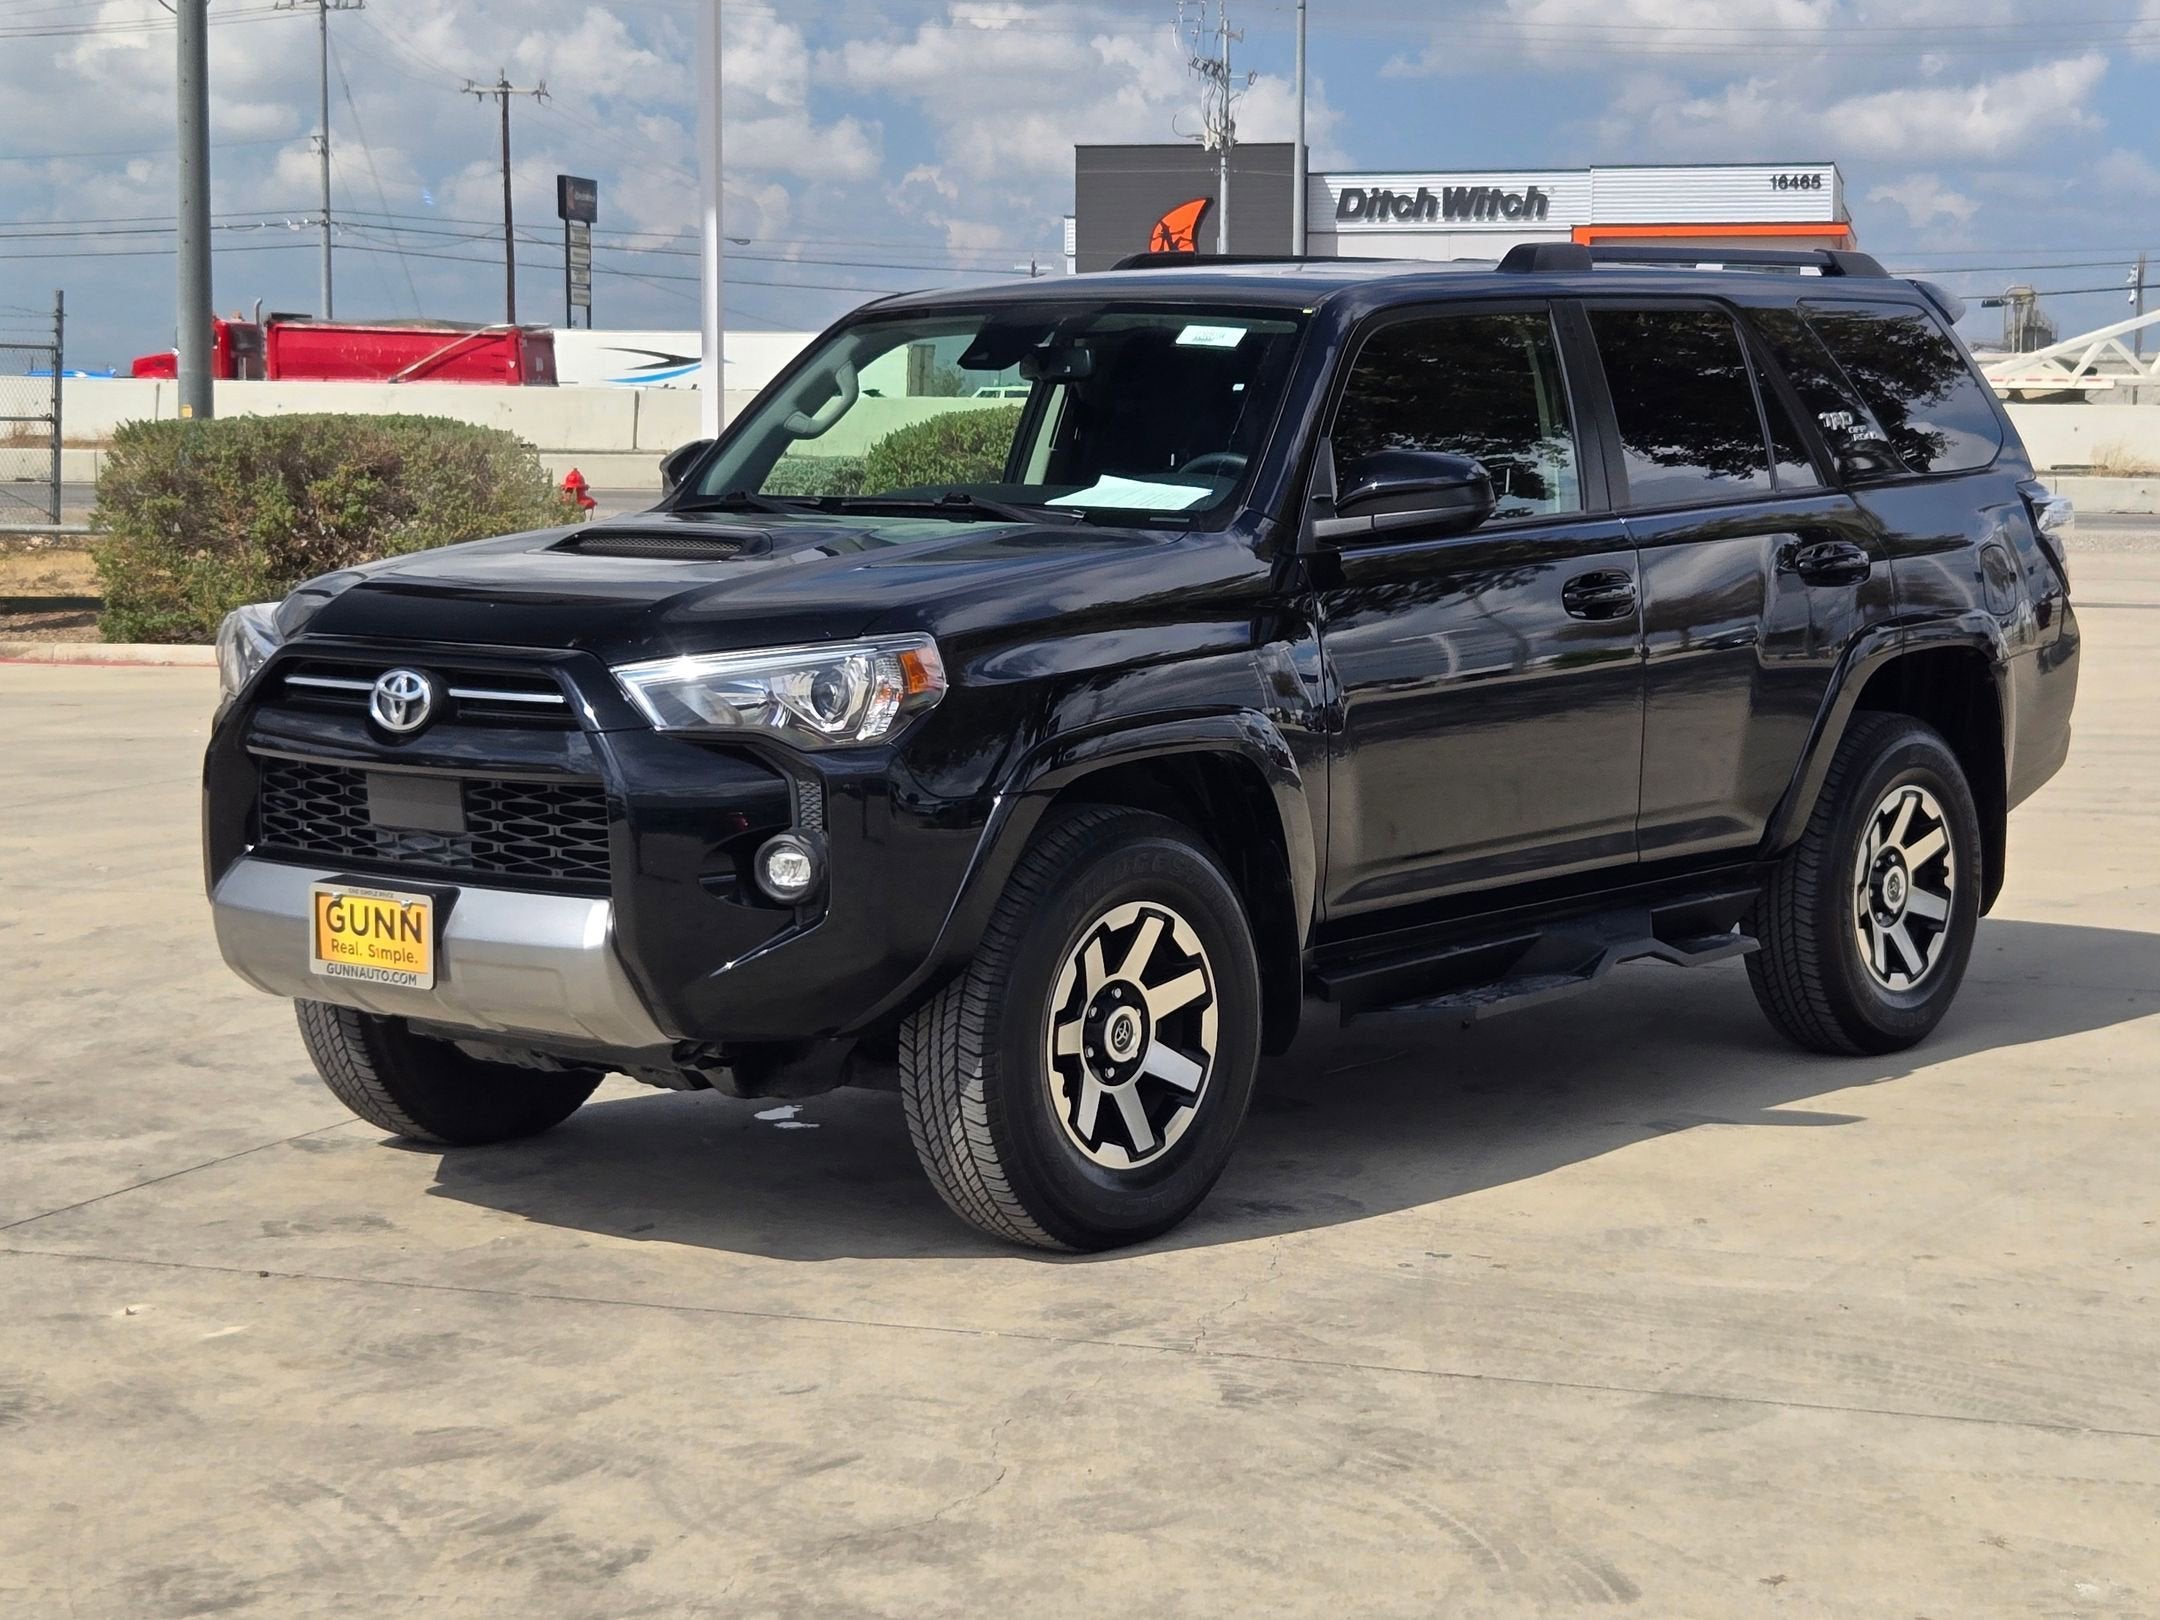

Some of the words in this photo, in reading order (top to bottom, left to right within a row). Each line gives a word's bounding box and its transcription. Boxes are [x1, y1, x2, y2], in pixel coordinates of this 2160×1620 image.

[1770, 174, 1822, 191] 16465
[1336, 187, 1439, 222] Ditch
[1442, 186, 1550, 221] Witch
[326, 901, 422, 944] GUNN
[331, 938, 363, 956] Real.
[368, 944, 418, 964] Simple.
[326, 963, 417, 986] GUNNAUTO.COM
